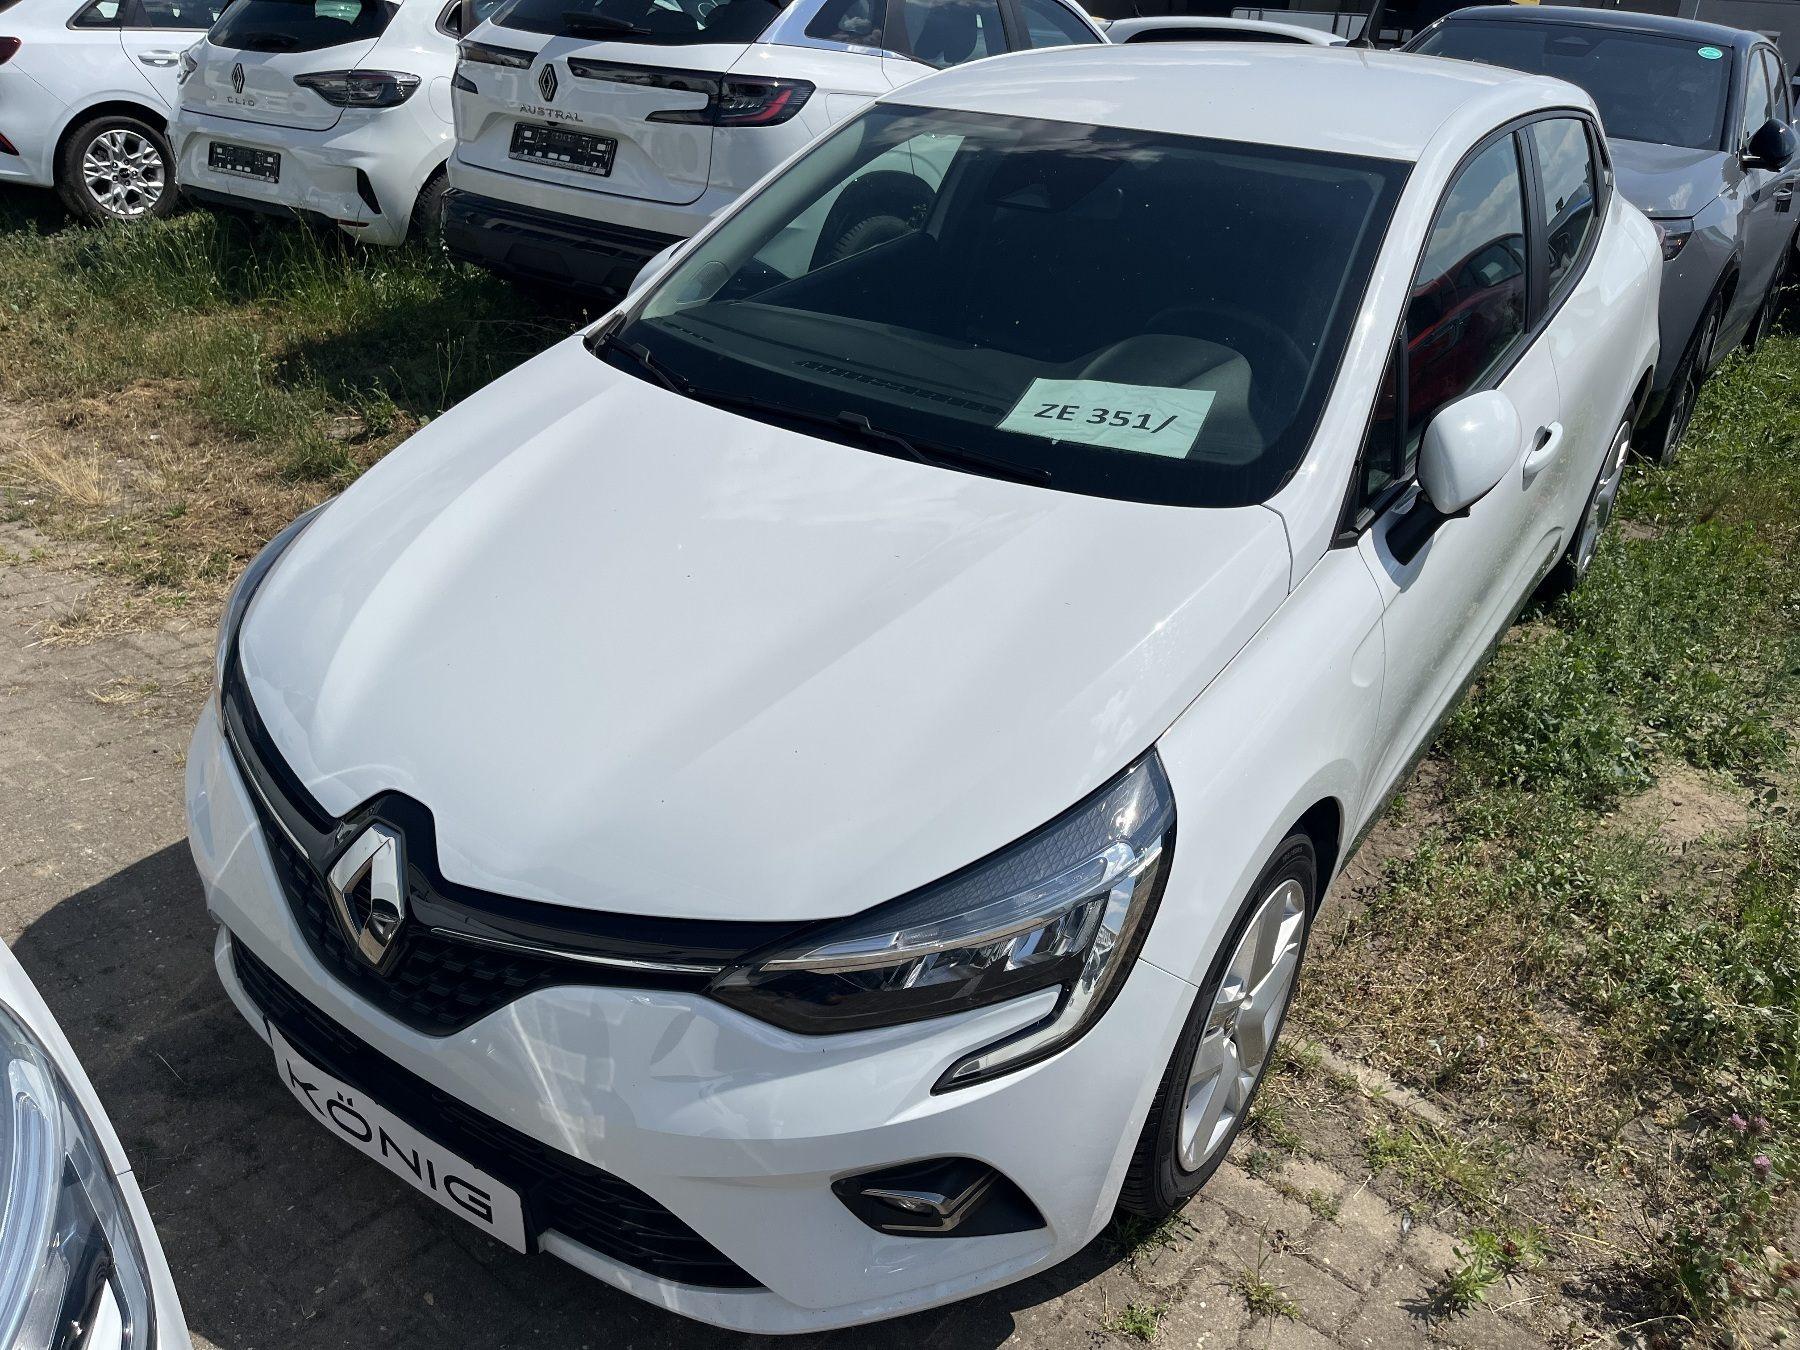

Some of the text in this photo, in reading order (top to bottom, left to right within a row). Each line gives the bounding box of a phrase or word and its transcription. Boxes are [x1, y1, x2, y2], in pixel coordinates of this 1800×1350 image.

[227, 96, 255, 106] CLIO
[520, 104, 584, 122] AUSTRAL
[1033, 403, 1080, 421] ZE
[285, 1058, 494, 1225] KÖNIG
